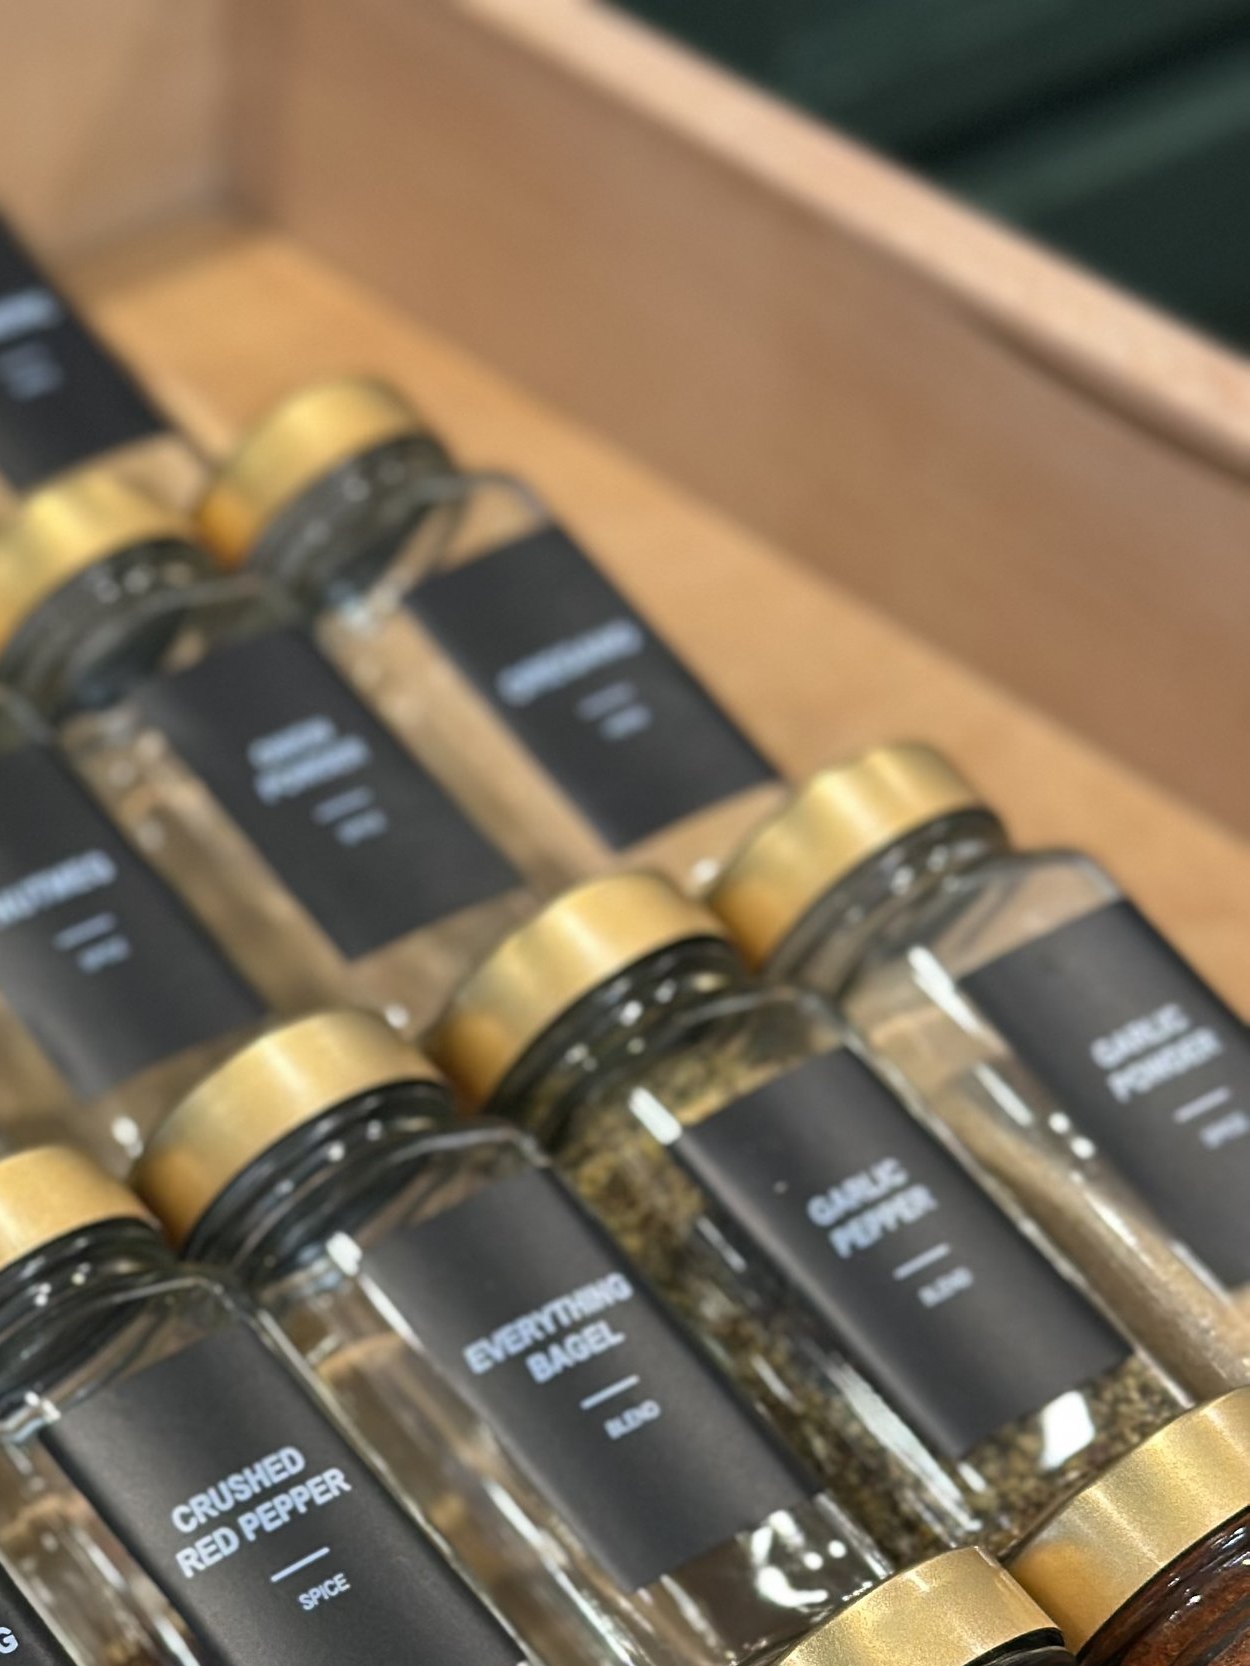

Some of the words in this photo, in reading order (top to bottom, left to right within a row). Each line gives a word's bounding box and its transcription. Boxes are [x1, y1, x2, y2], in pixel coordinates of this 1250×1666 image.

[807, 1158, 908, 1227] GARLIC
[829, 1184, 937, 1258] PEPPER
[464, 1272, 633, 1374] EVERYTHING
[525, 1320, 625, 1383] BAGEL
[604, 1400, 661, 1440] BLEND
[172, 1447, 305, 1532] CRUSHED
[176, 1527, 239, 1578] RED
[238, 1468, 351, 1541] PEPPER
[299, 1573, 350, 1610] SPICE
